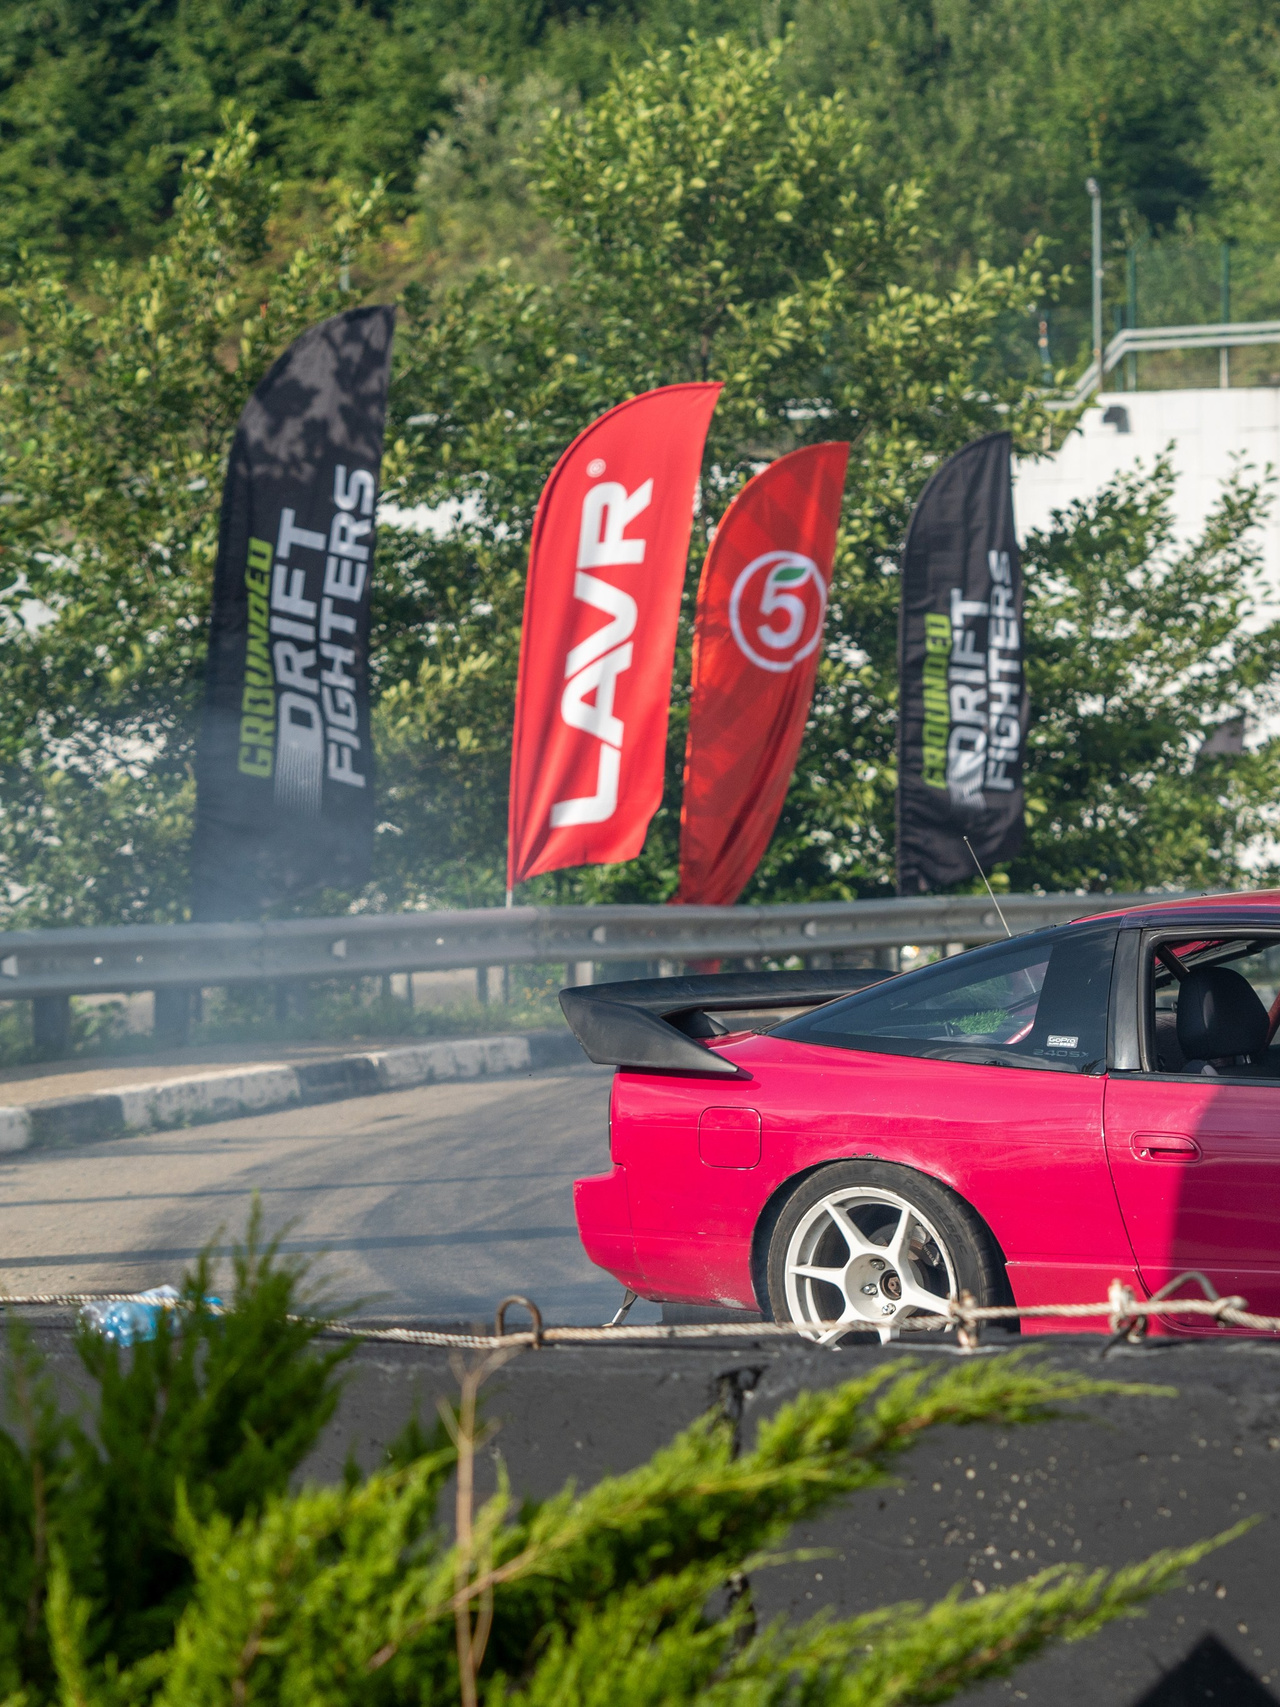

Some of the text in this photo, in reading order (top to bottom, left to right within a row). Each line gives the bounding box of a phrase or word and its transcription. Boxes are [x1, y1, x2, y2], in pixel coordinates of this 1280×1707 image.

[238, 536, 275, 778] GROUNDED
[270, 507, 327, 785] DRIFT
[319, 464, 375, 788] FIGHTERS
[550, 478, 654, 828] LAVR
[757, 562, 811, 650] 5
[922, 612, 952, 790] GROUNDED
[947, 587, 989, 798] DRIFT
[984, 550, 1021, 791] FIGHTERS
[1033, 1048, 1090, 1058] 240SX
